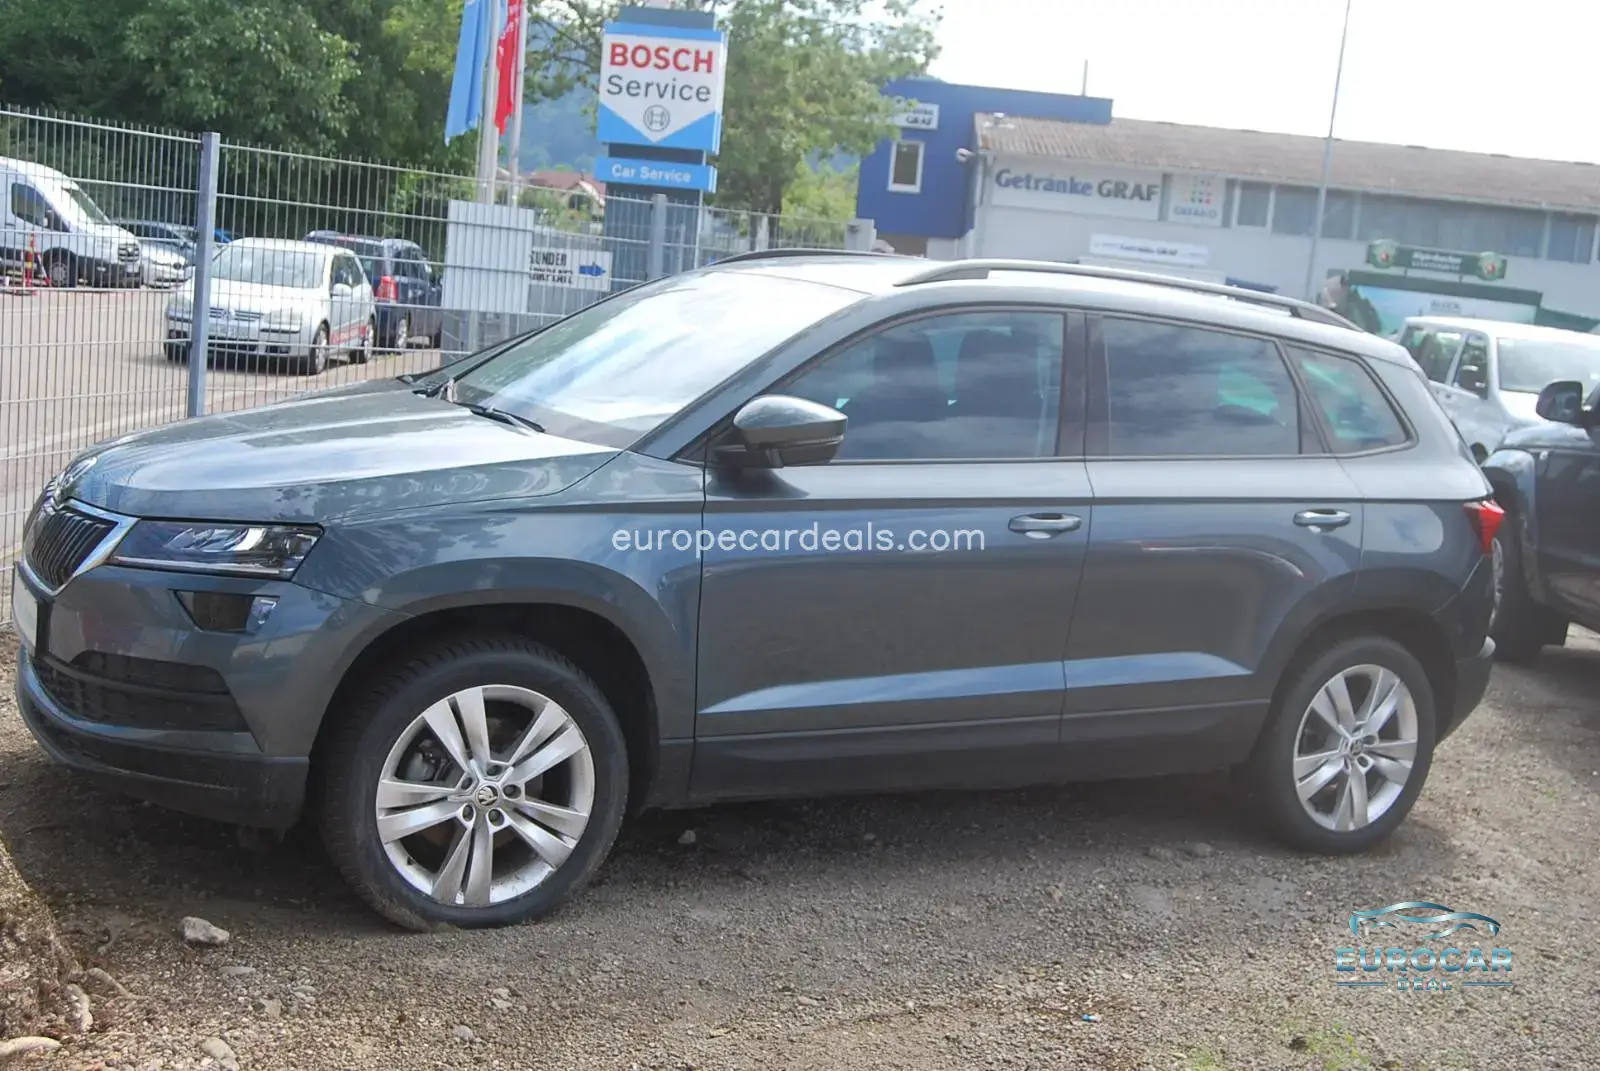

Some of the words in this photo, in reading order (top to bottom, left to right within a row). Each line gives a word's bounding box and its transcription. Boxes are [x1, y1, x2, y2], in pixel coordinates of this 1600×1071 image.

[609, 42, 713, 73] BOSCH
[606, 75, 711, 102] Service
[611, 164, 637, 178] Car
[639, 166, 692, 183] Service
[1097, 179, 1160, 202] GRAF
